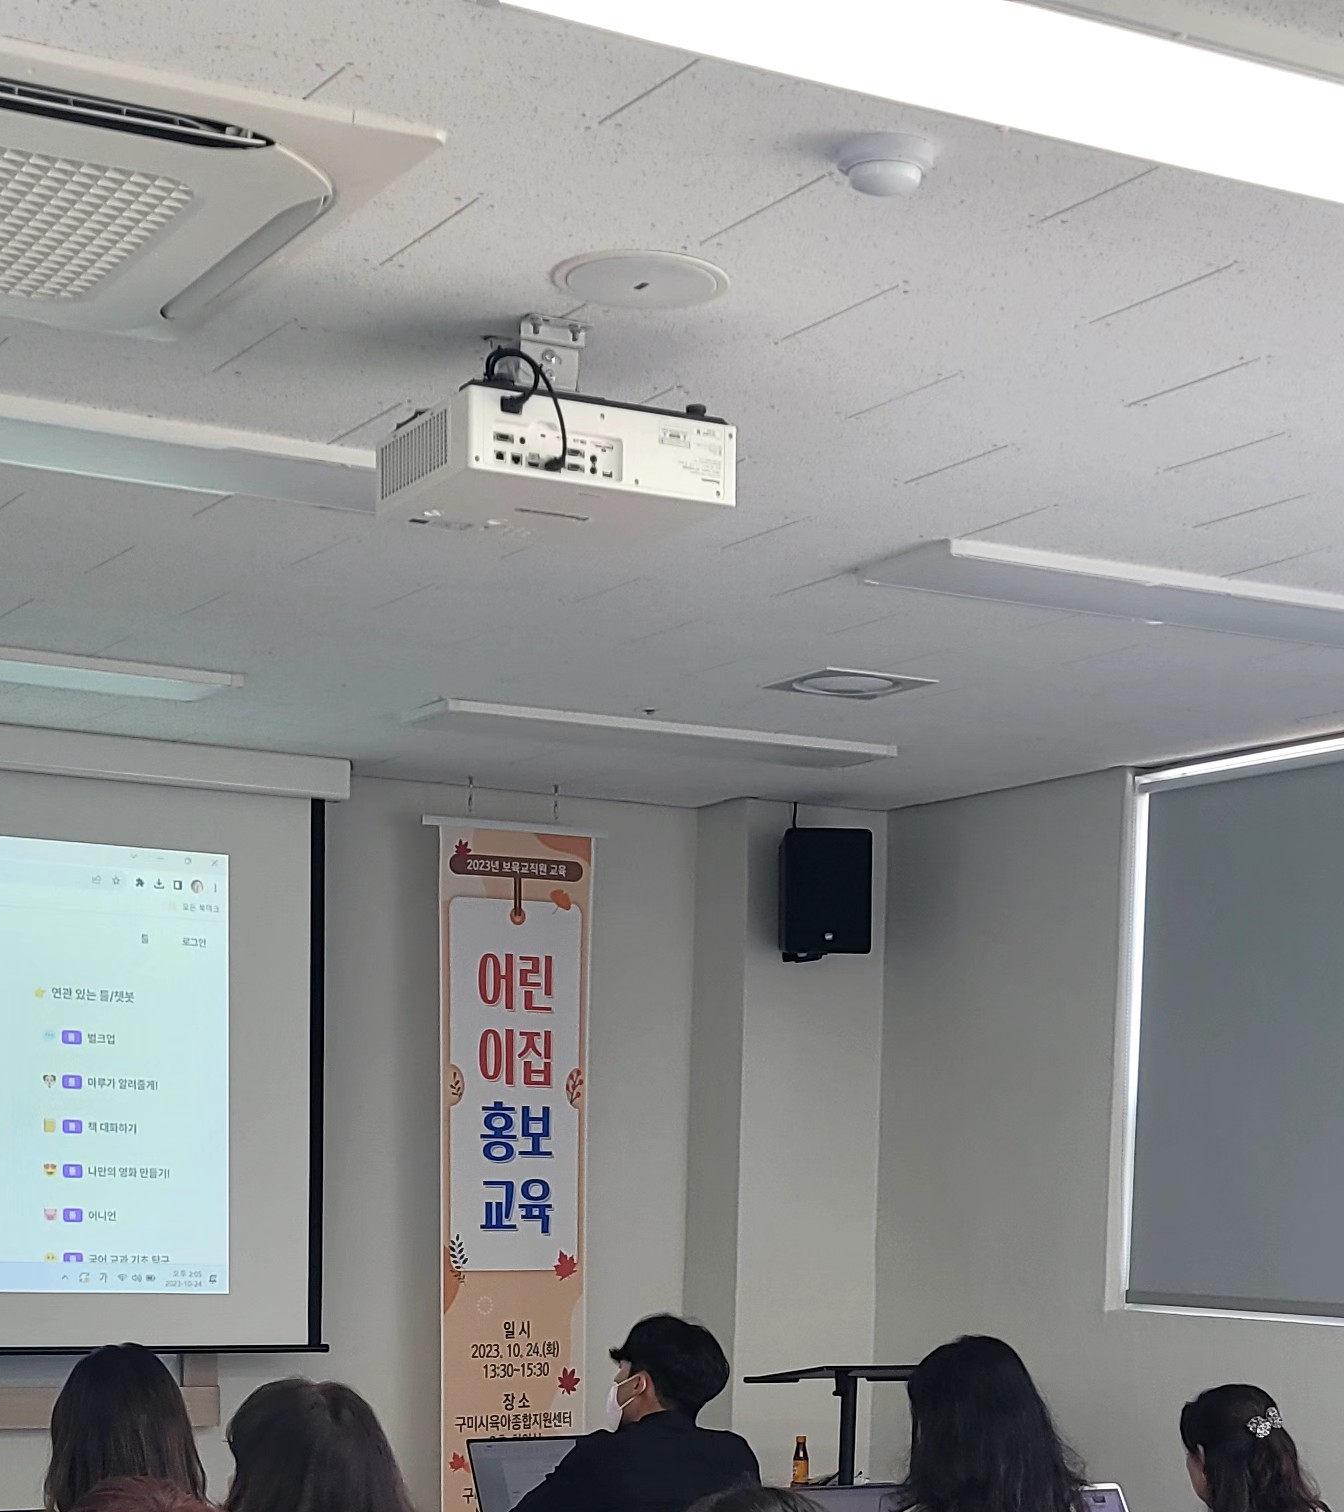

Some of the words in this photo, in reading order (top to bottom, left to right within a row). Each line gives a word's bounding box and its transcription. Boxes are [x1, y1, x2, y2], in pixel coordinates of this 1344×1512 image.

[466, 859, 499, 872] 2023년
[502, 861, 547, 876] 보육교직원
[549, 864, 567, 877] 교육
[478, 953, 553, 1012] 어린
[76, 989, 96, 1001] 있는
[479, 1029, 552, 1087] 이집
[480, 1101, 553, 1162] 홍보
[480, 1178, 553, 1234] 교육
[471, 1343, 503, 1358] 2023.
[507, 1343, 524, 1358] 10.
[526, 1340, 560, 1358] 24.(화)
[483, 1362, 550, 1379] 13:30~15:30
[455, 1411, 572, 1433] 구미시육아종합지원센터
